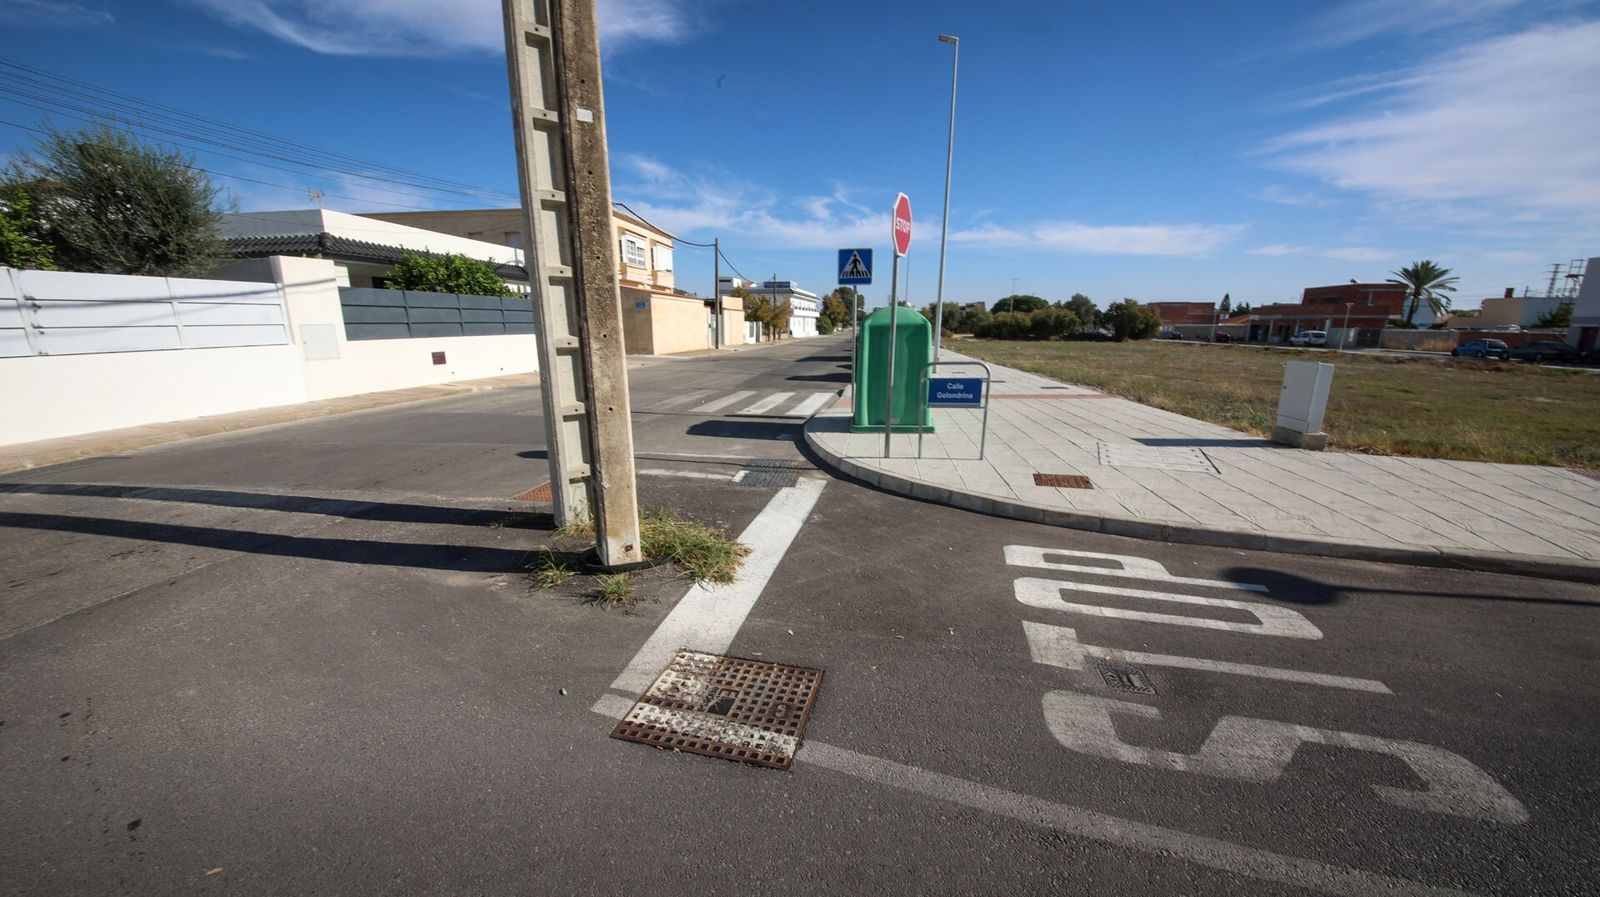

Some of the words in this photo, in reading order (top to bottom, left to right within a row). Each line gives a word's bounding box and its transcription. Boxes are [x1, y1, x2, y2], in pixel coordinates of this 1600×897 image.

[896, 217, 911, 234] STOP
[946, 382, 965, 390] Calle
[936, 391, 974, 399] Golondrina
[1003, 544, 1530, 825] STOP
